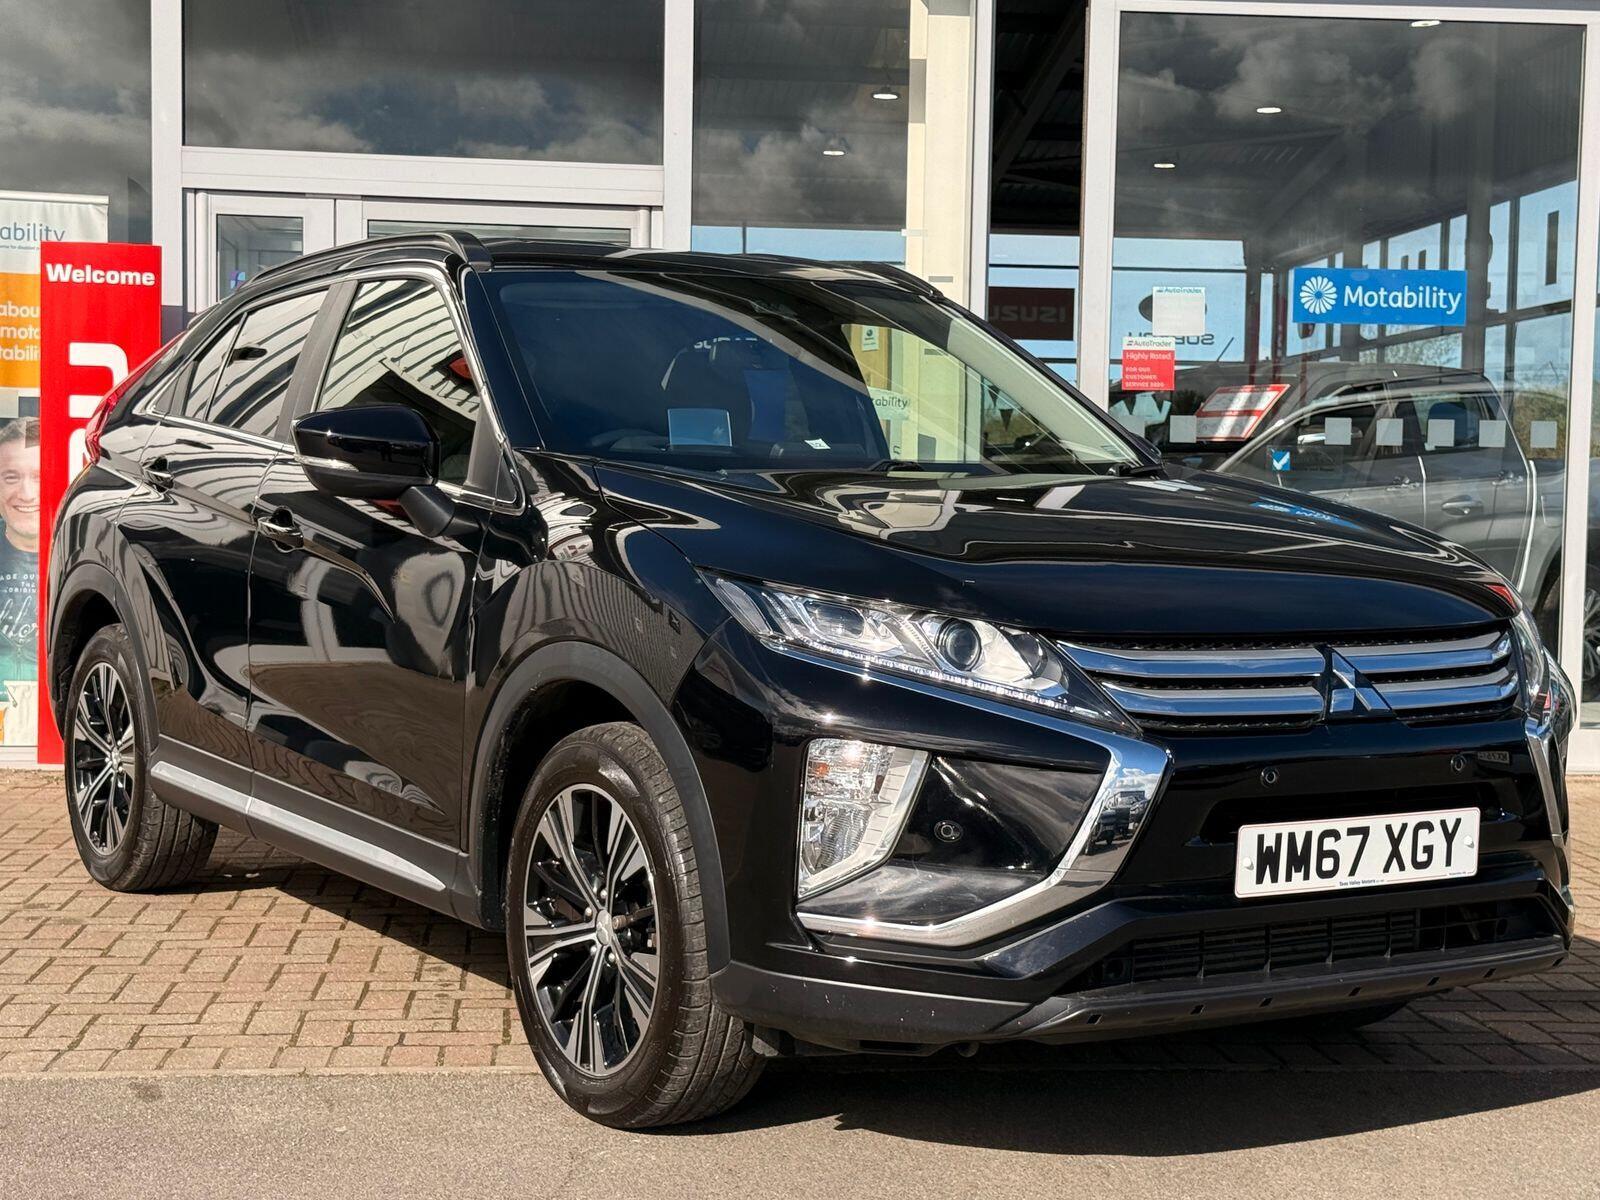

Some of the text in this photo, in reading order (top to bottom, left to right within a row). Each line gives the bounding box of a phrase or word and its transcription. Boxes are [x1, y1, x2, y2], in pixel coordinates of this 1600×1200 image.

[46, 263, 156, 286] Welcome
[1343, 285, 1462, 315] Motability
[1255, 817, 1462, 885] WM67 XGY
